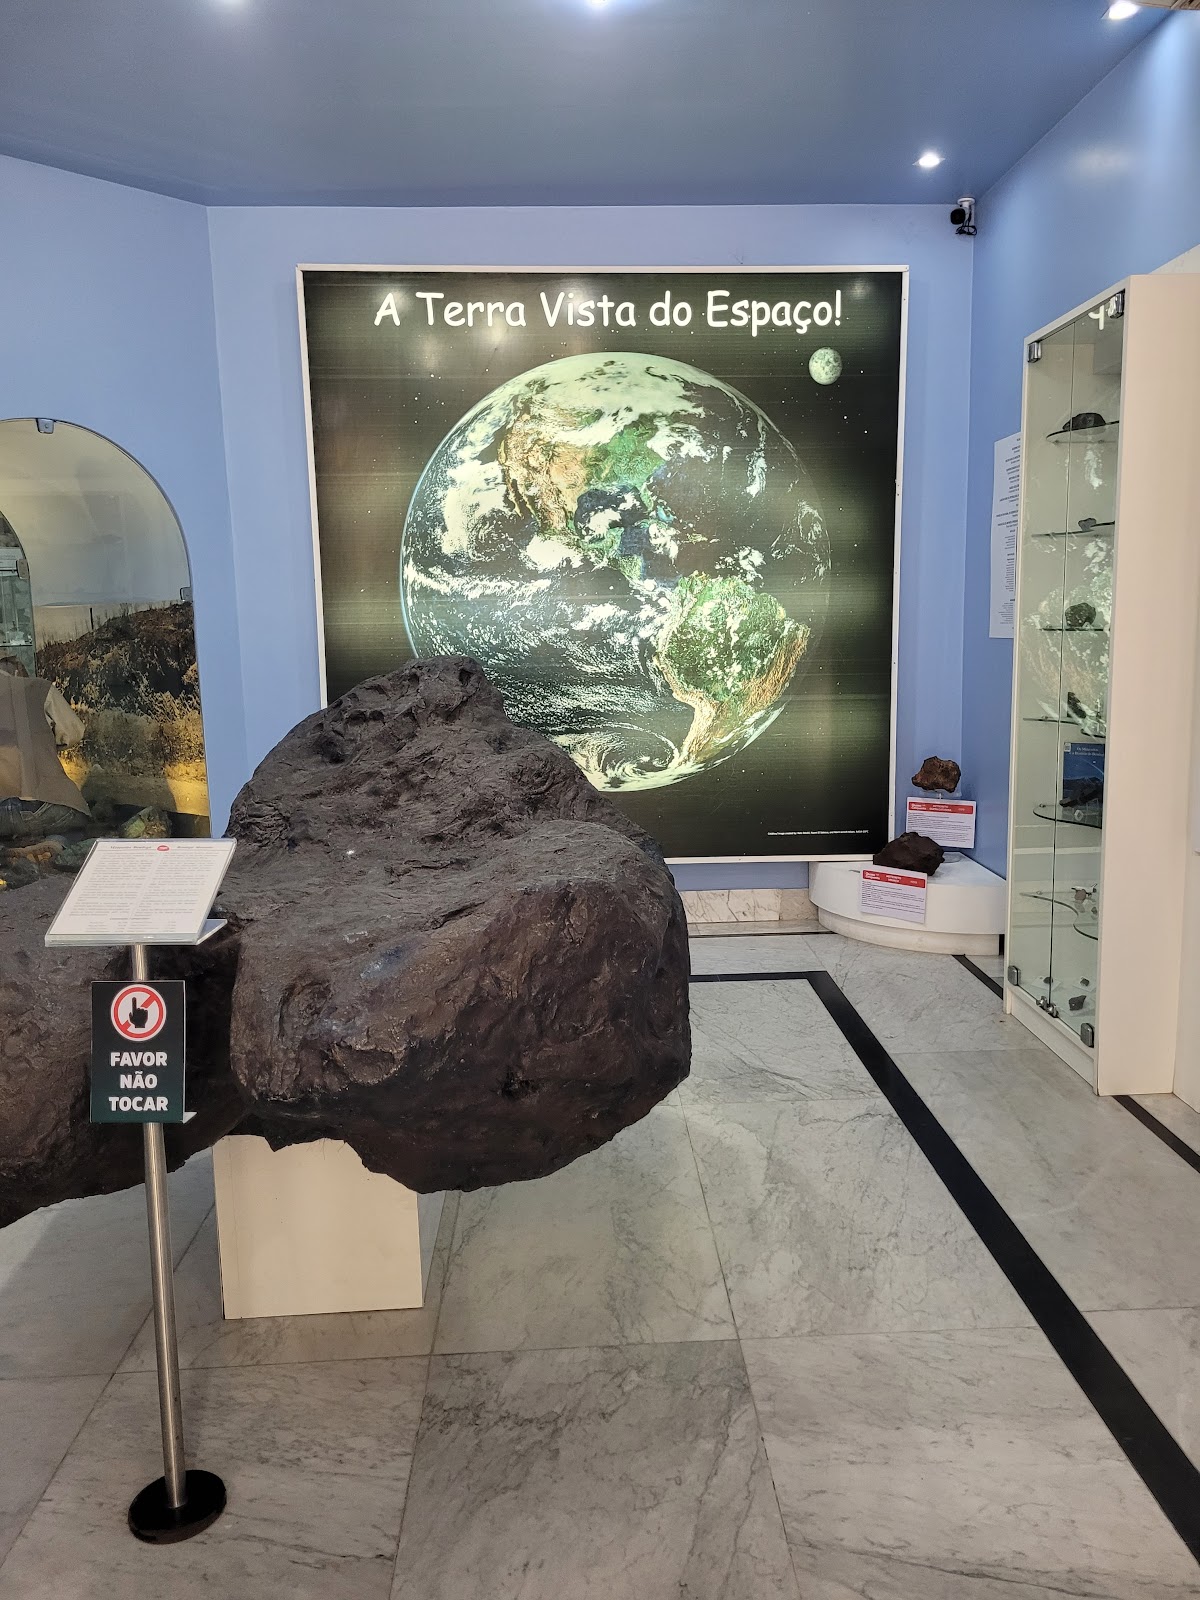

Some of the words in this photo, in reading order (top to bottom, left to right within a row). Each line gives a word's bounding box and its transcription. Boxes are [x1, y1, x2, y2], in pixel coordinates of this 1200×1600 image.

[374, 292, 401, 326] A
[415, 291, 527, 327] Terra
[540, 290, 637, 328] Vista
[649, 290, 692, 327] do
[706, 289, 842, 337] Espaço!
[110, 1051, 168, 1067] FAVOR
[119, 1070, 158, 1089] NÃO
[108, 1096, 169, 1112] TOCAR
